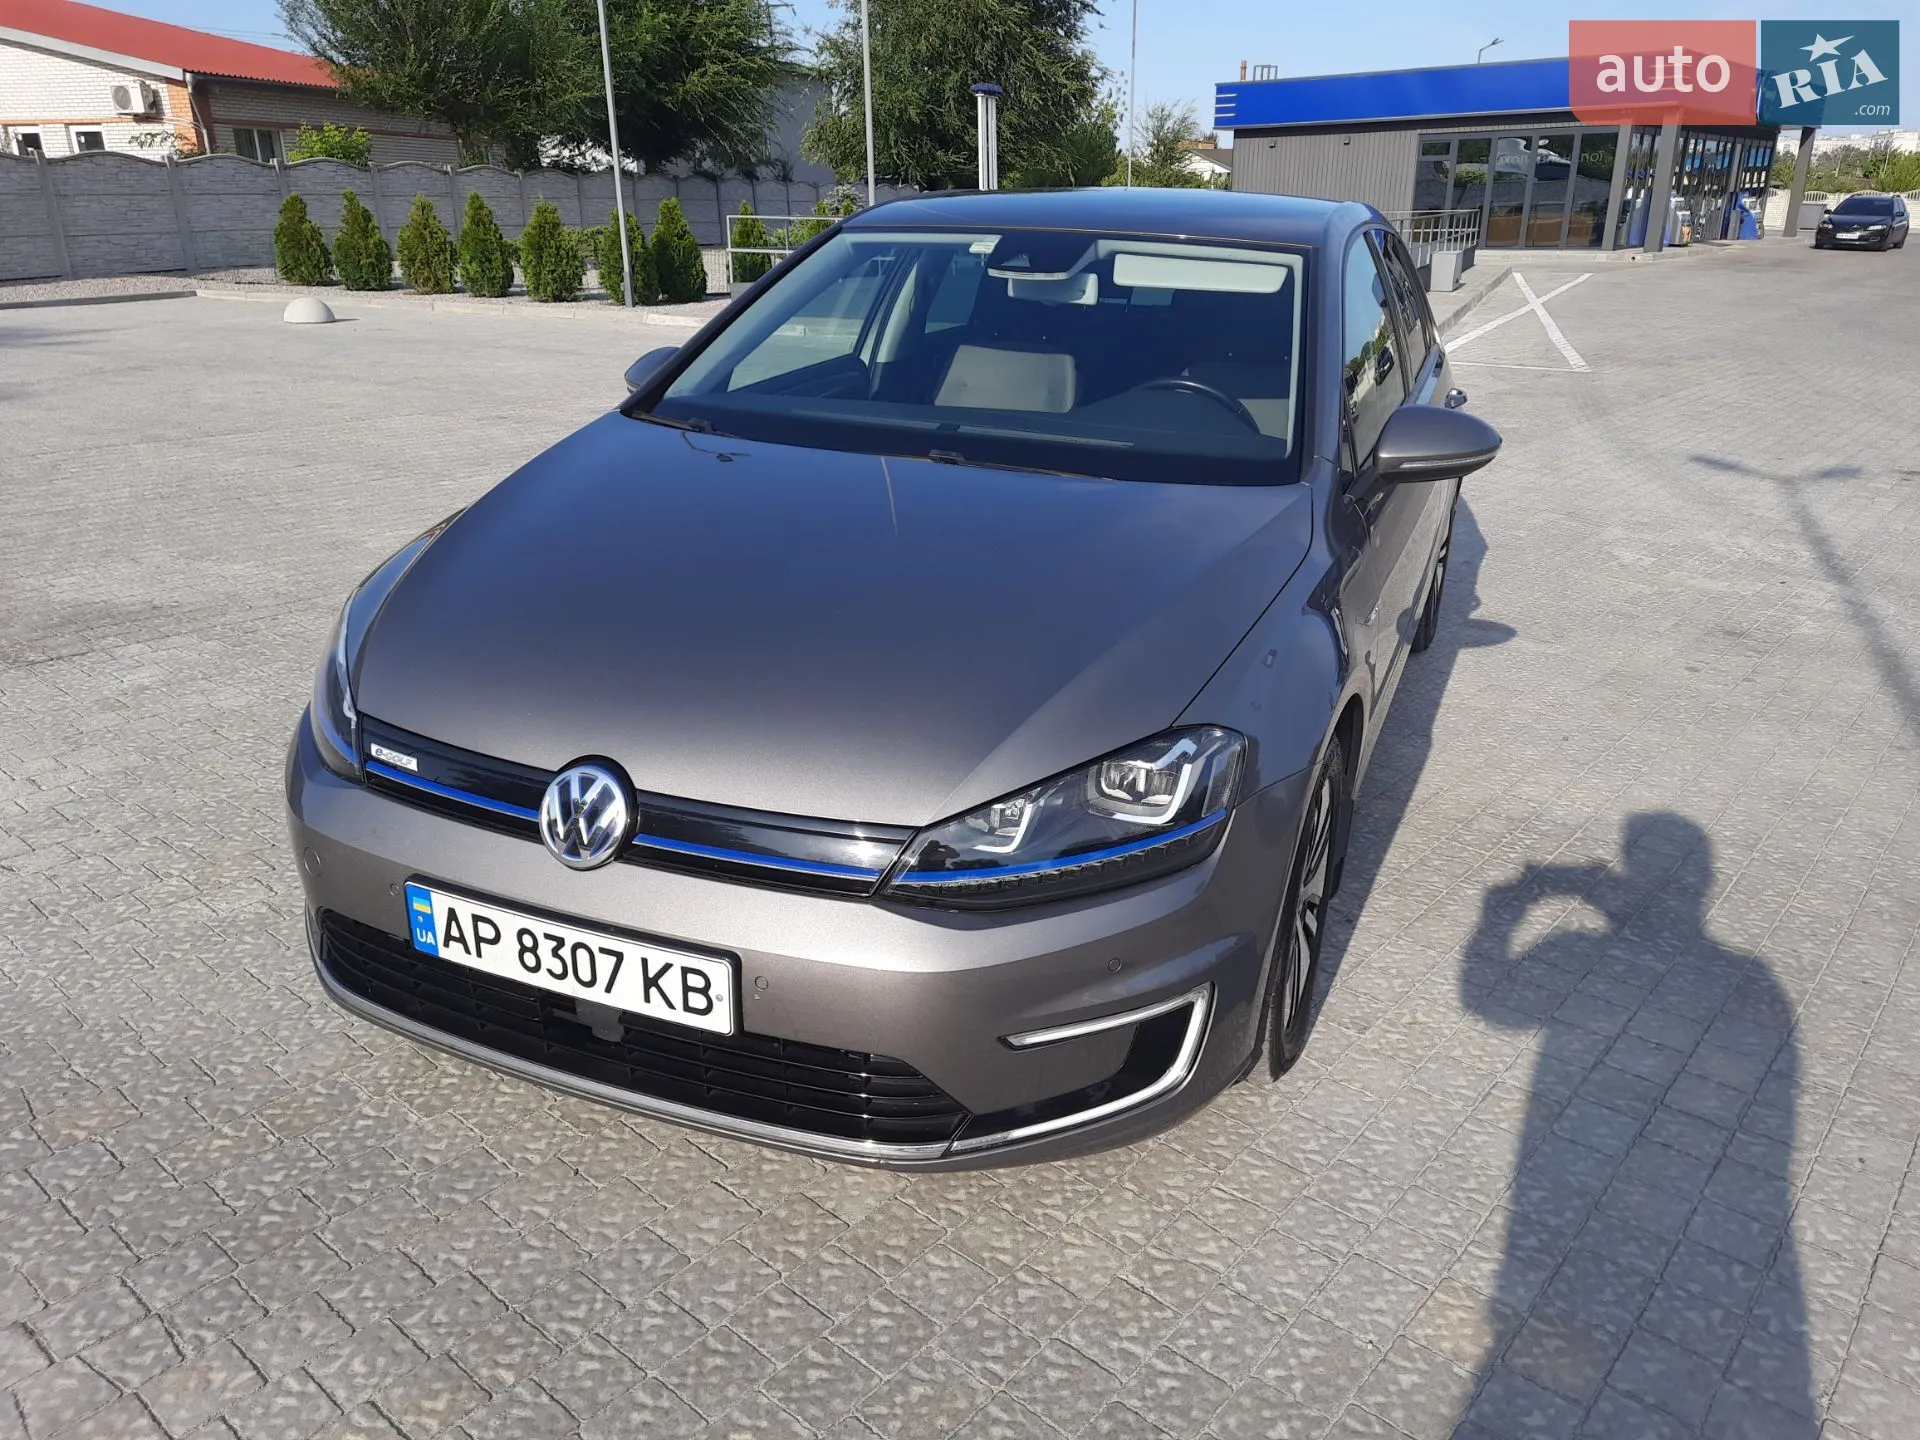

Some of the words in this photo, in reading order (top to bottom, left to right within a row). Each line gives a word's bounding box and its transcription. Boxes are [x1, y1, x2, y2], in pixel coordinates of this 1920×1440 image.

[416, 926, 436, 947] UA
[443, 907, 501, 958] AP
[516, 927, 625, 994] 8307
[640, 956, 714, 1016] KB
